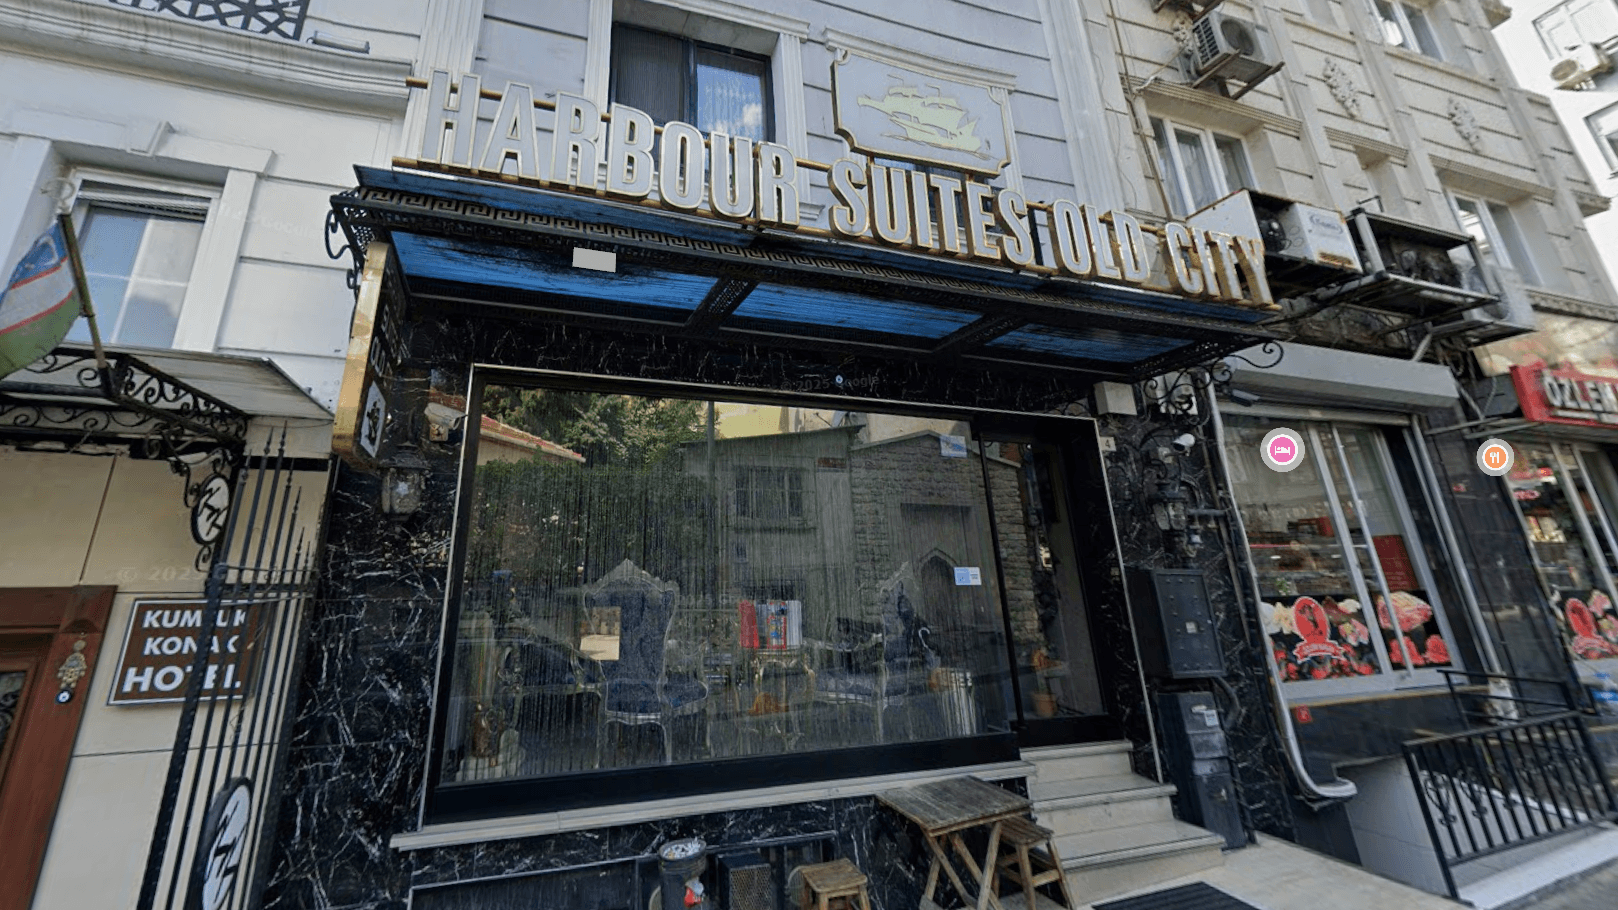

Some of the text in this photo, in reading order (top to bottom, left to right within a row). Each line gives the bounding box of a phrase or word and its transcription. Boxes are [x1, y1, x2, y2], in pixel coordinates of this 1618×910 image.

[417, 67, 1276, 305] HARBOUR SUITES OLD CITY
[1105, 439, 1111, 449] 4
[142, 609, 247, 628] KUMUK
[122, 664, 242, 693] HOEL
